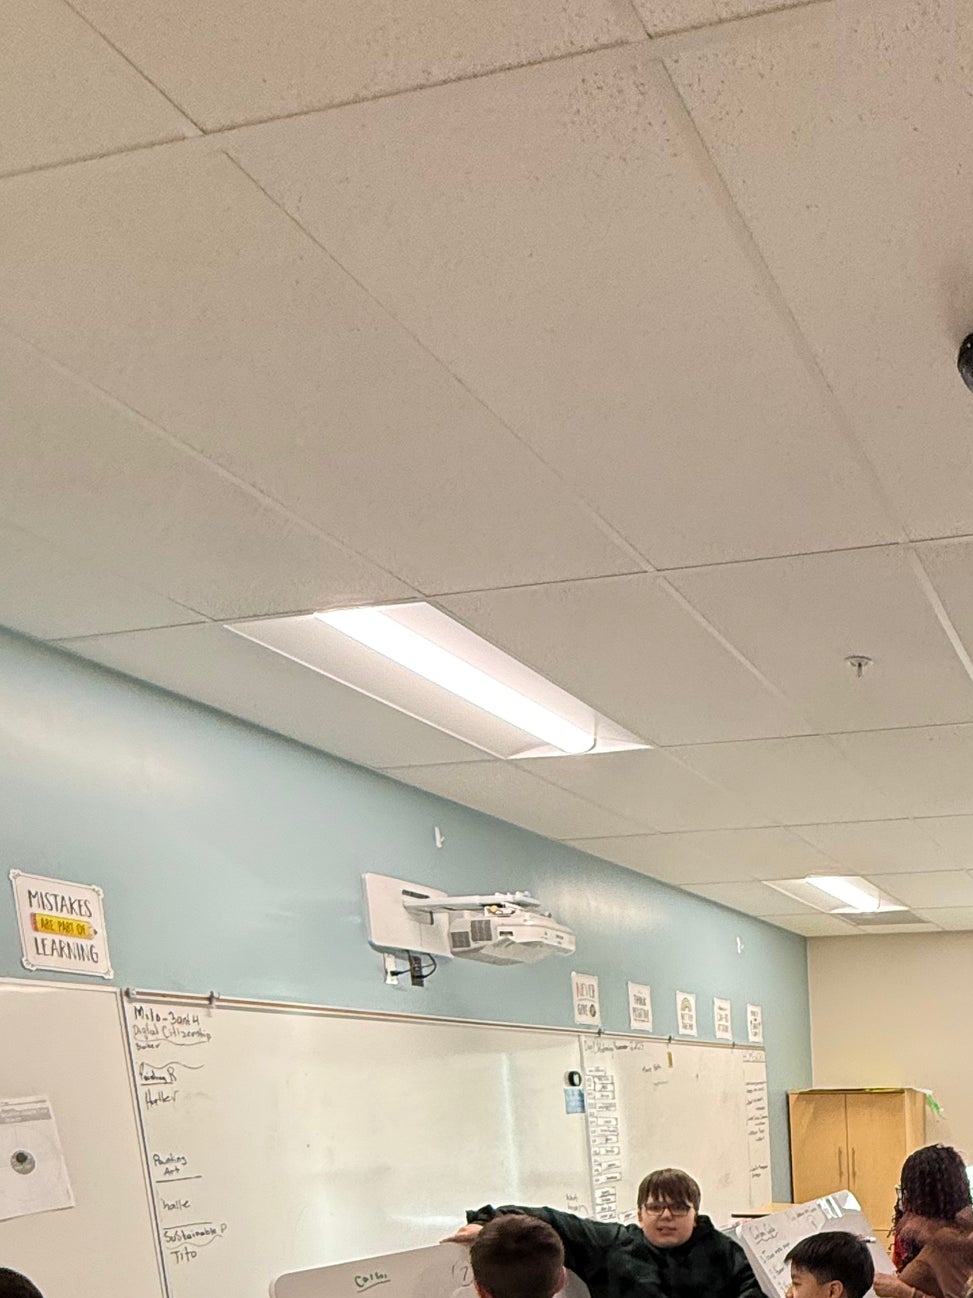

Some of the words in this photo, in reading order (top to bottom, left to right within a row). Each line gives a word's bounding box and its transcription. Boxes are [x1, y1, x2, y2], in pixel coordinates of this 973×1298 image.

[28, 889, 92, 918] MISTAKES
[40, 917, 54, 931] ARE
[57, 921, 74, 934] PART
[76, 924, 87, 936] OF
[34, 937, 99, 963] LEARNING
[163, 1165, 181, 1176] Art
